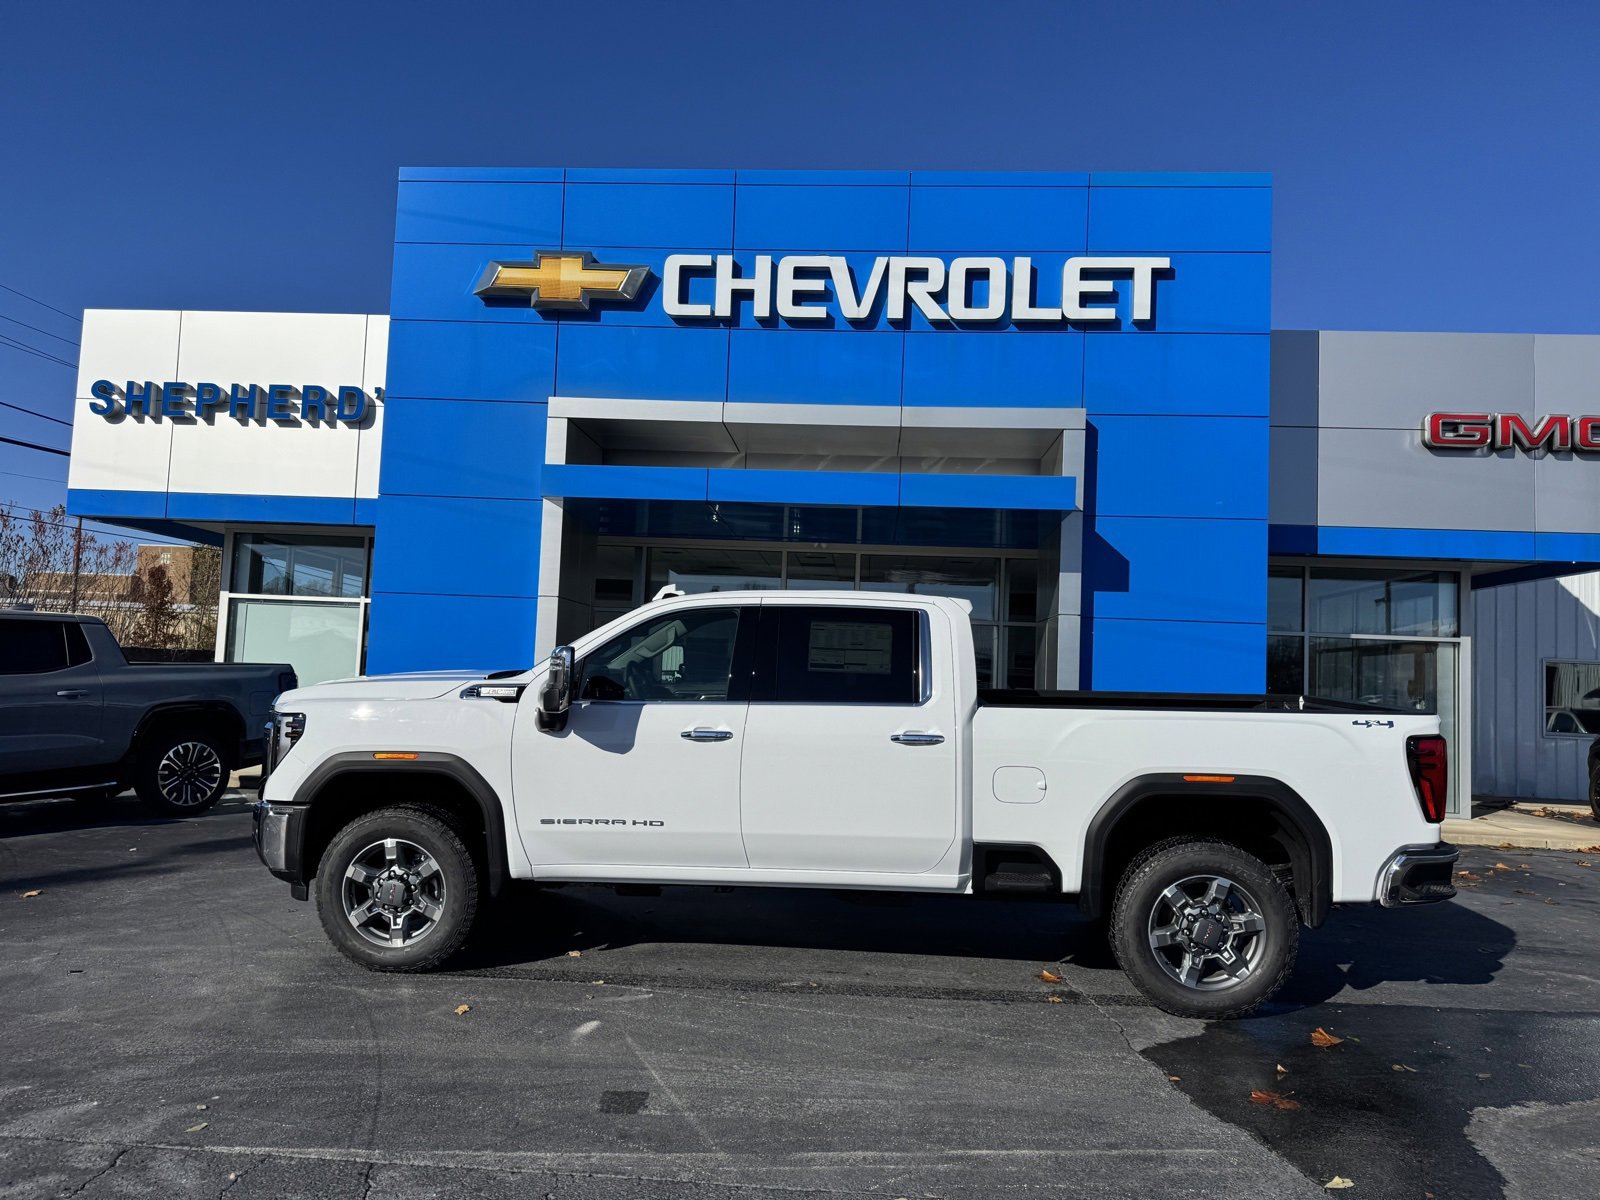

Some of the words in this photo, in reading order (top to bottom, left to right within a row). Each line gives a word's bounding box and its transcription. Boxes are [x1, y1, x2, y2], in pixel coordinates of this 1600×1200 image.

[662, 254, 1171, 323] CHEVROLET
[540, 818, 627, 826] SIERRA
[632, 819, 665, 827] HD
